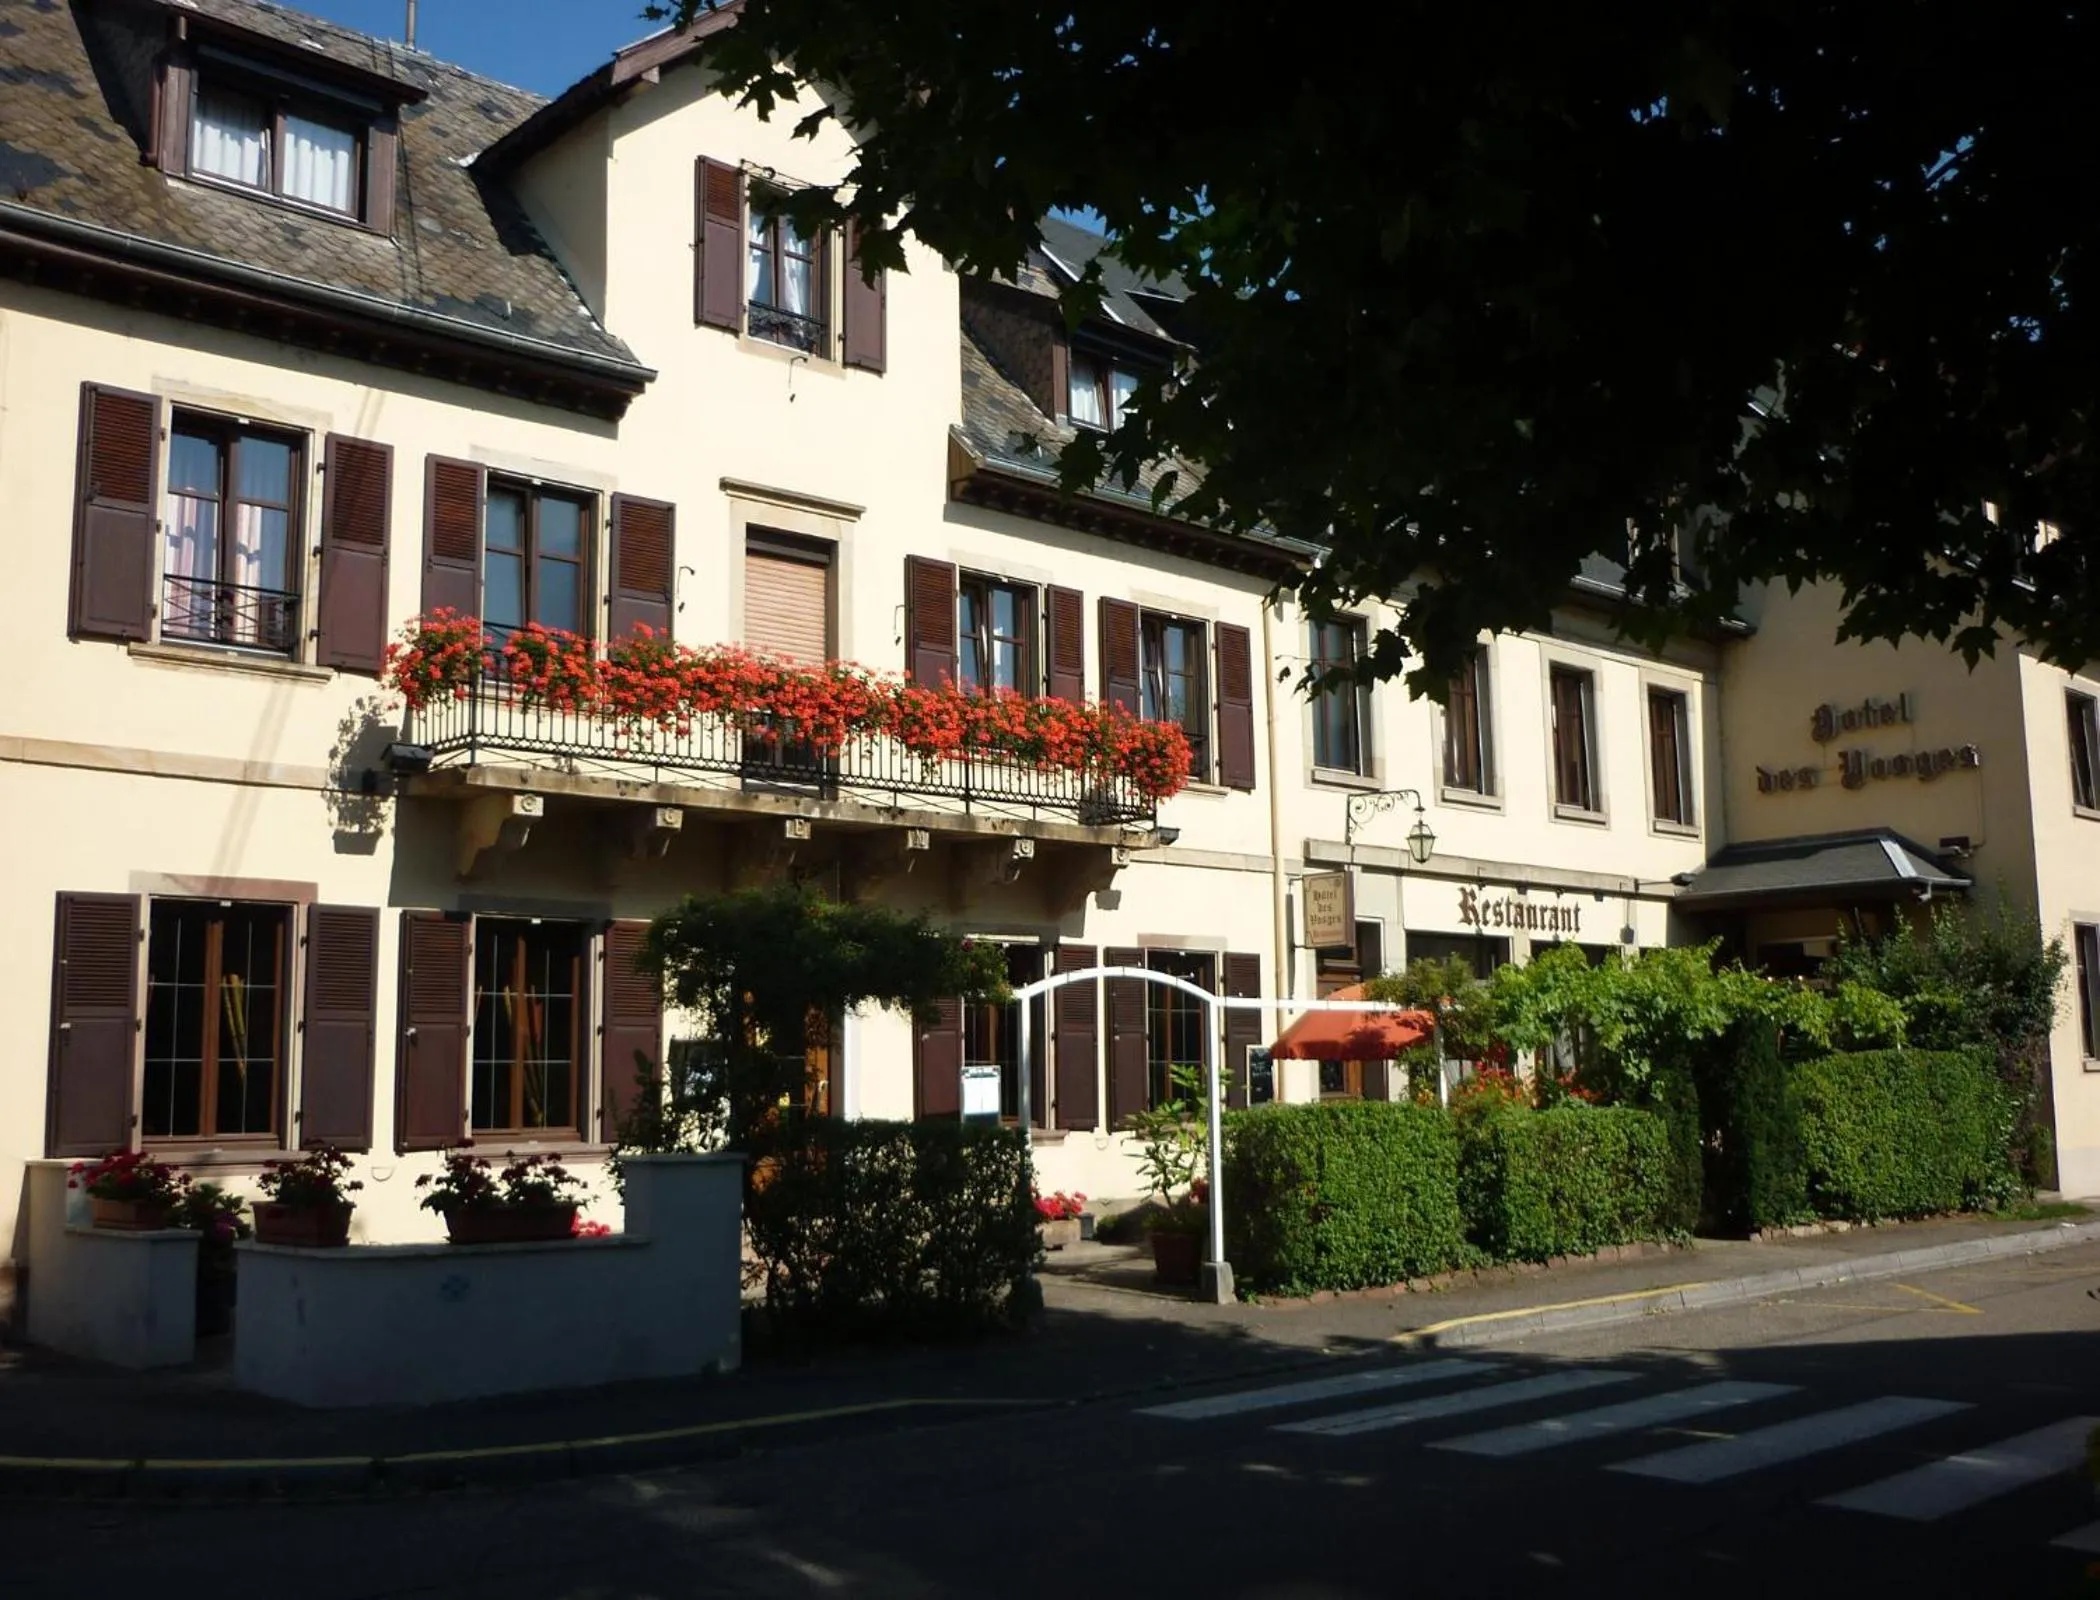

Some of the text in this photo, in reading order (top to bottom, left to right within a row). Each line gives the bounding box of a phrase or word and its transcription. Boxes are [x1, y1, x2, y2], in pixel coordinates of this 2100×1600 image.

[1756, 745, 1980, 794] des Vosges
[1458, 886, 1580, 932] Restaurant
